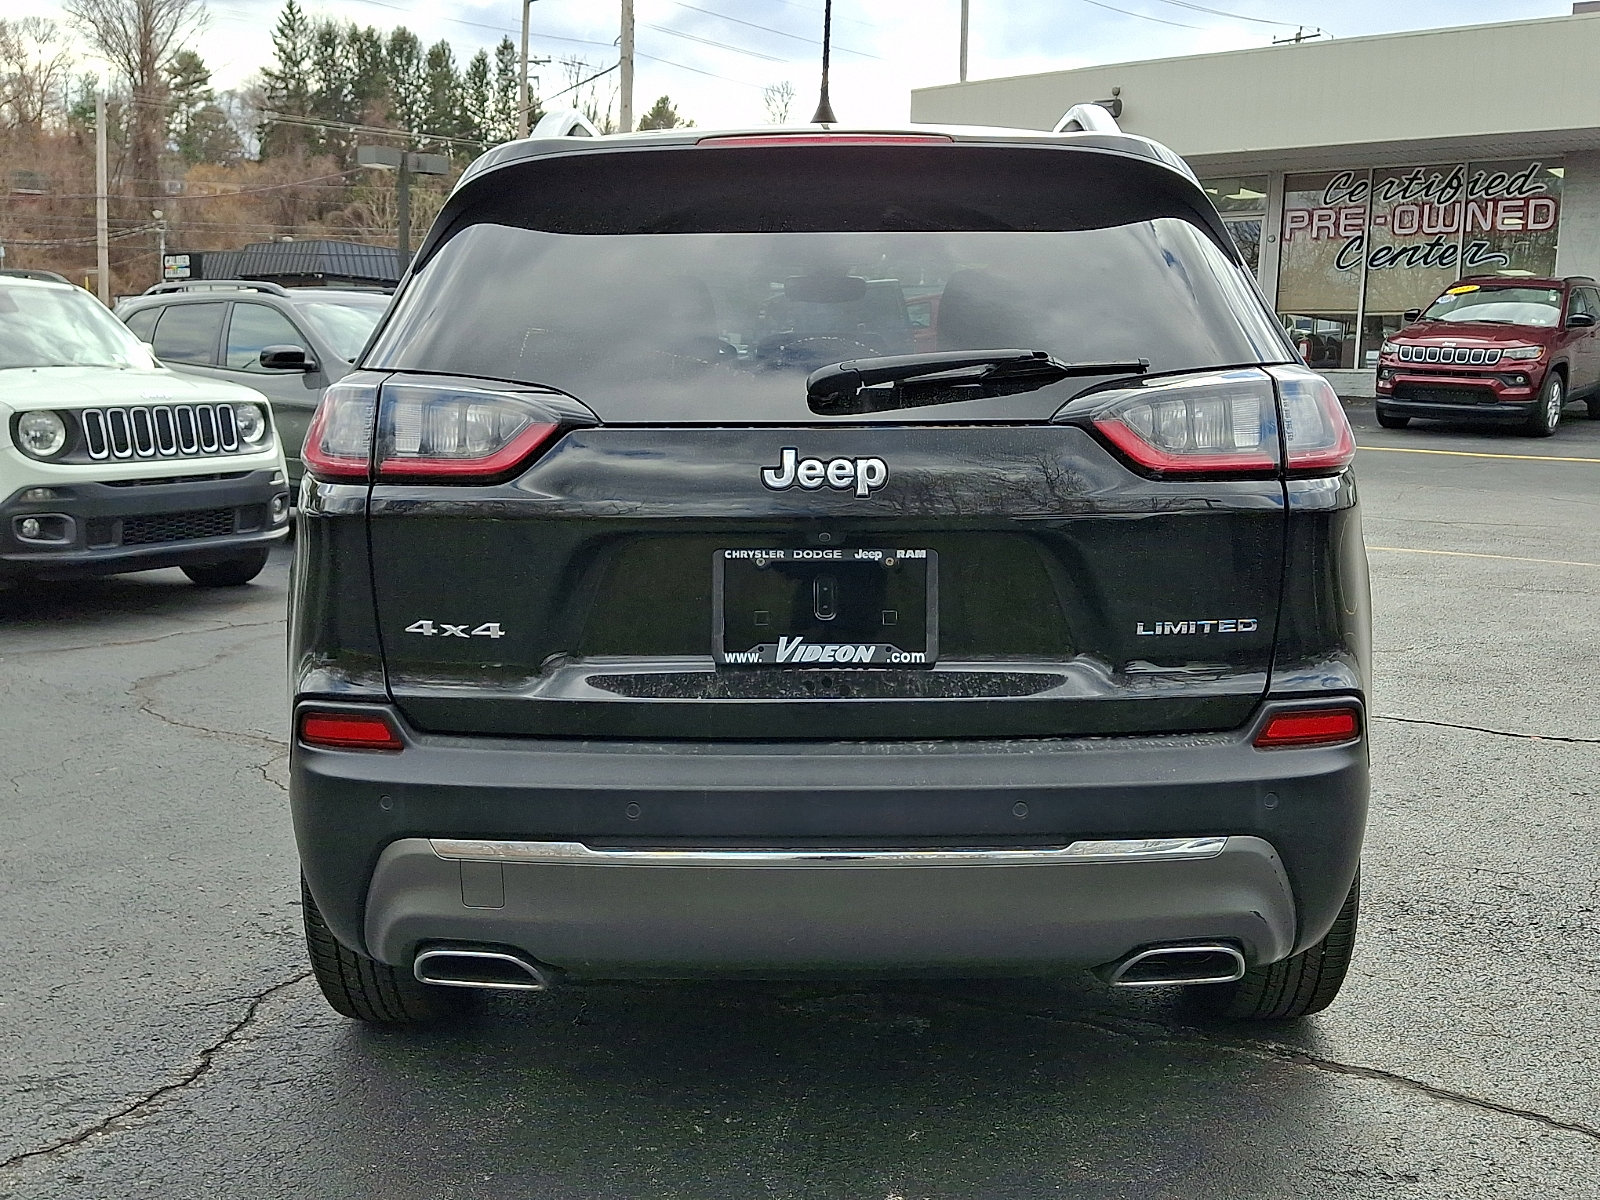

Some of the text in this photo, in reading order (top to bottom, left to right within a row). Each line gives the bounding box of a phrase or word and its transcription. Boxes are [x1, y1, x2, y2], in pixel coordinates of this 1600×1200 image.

[1323, 162, 1547, 206] Certified
[1283, 198, 1557, 240] PRE-OWNED
[1335, 234, 1508, 270] Center
[761, 447, 888, 498] Jeep
[724, 549, 926, 561] CHRYSLER DODGE Jeep RAM
[1136, 619, 1258, 635] LIMITED
[724, 636, 926, 663] www. VIDEON .com
